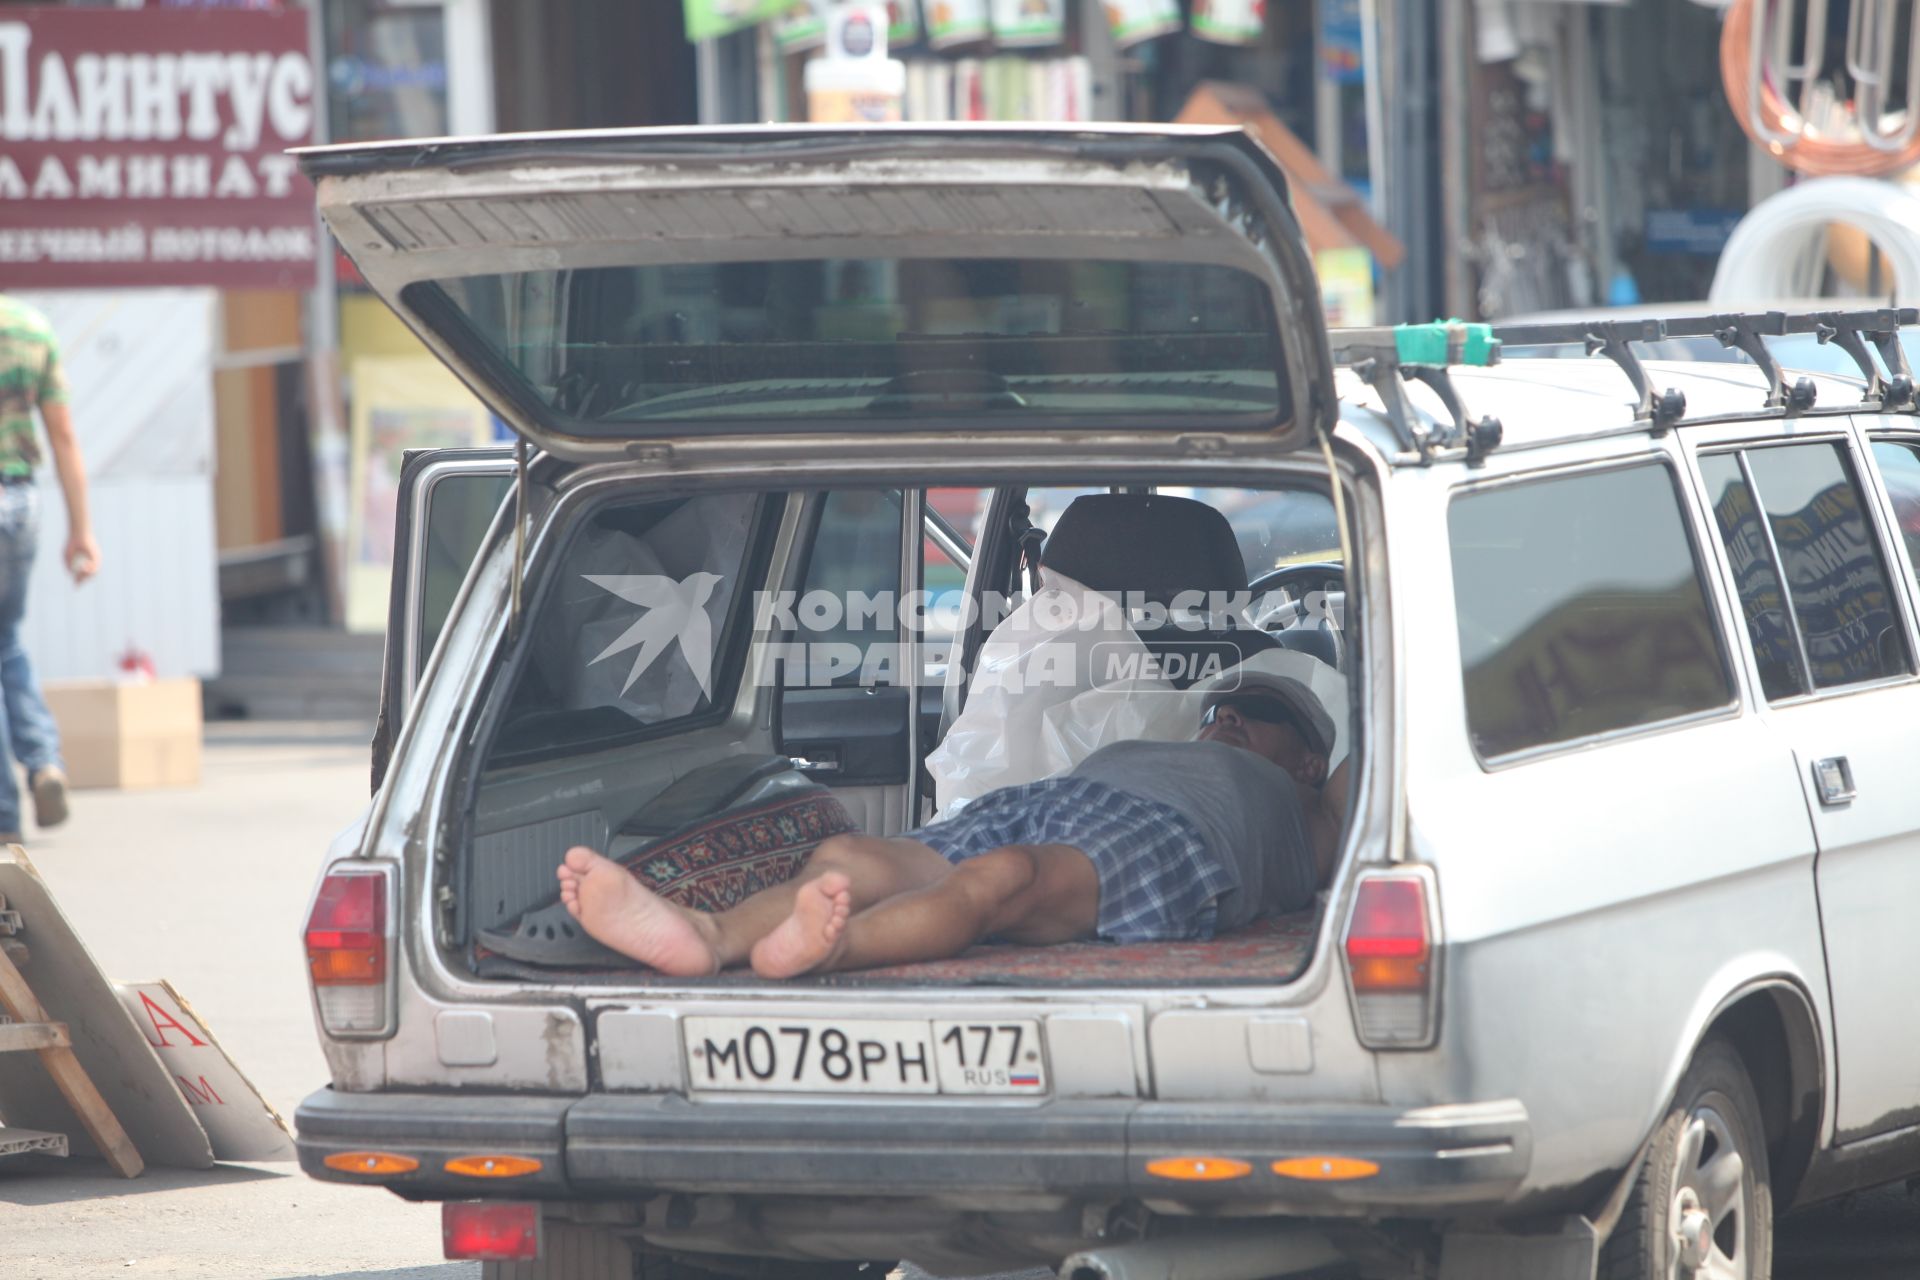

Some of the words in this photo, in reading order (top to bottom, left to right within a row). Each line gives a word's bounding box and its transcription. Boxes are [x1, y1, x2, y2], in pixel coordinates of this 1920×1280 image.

[151, 226, 315, 262] ПОТОЛОК
[138, 990, 208, 1047] А
[942, 1025, 1023, 1067] 177
[176, 1074, 225, 1105] М
[964, 1070, 1007, 1086] RUS
